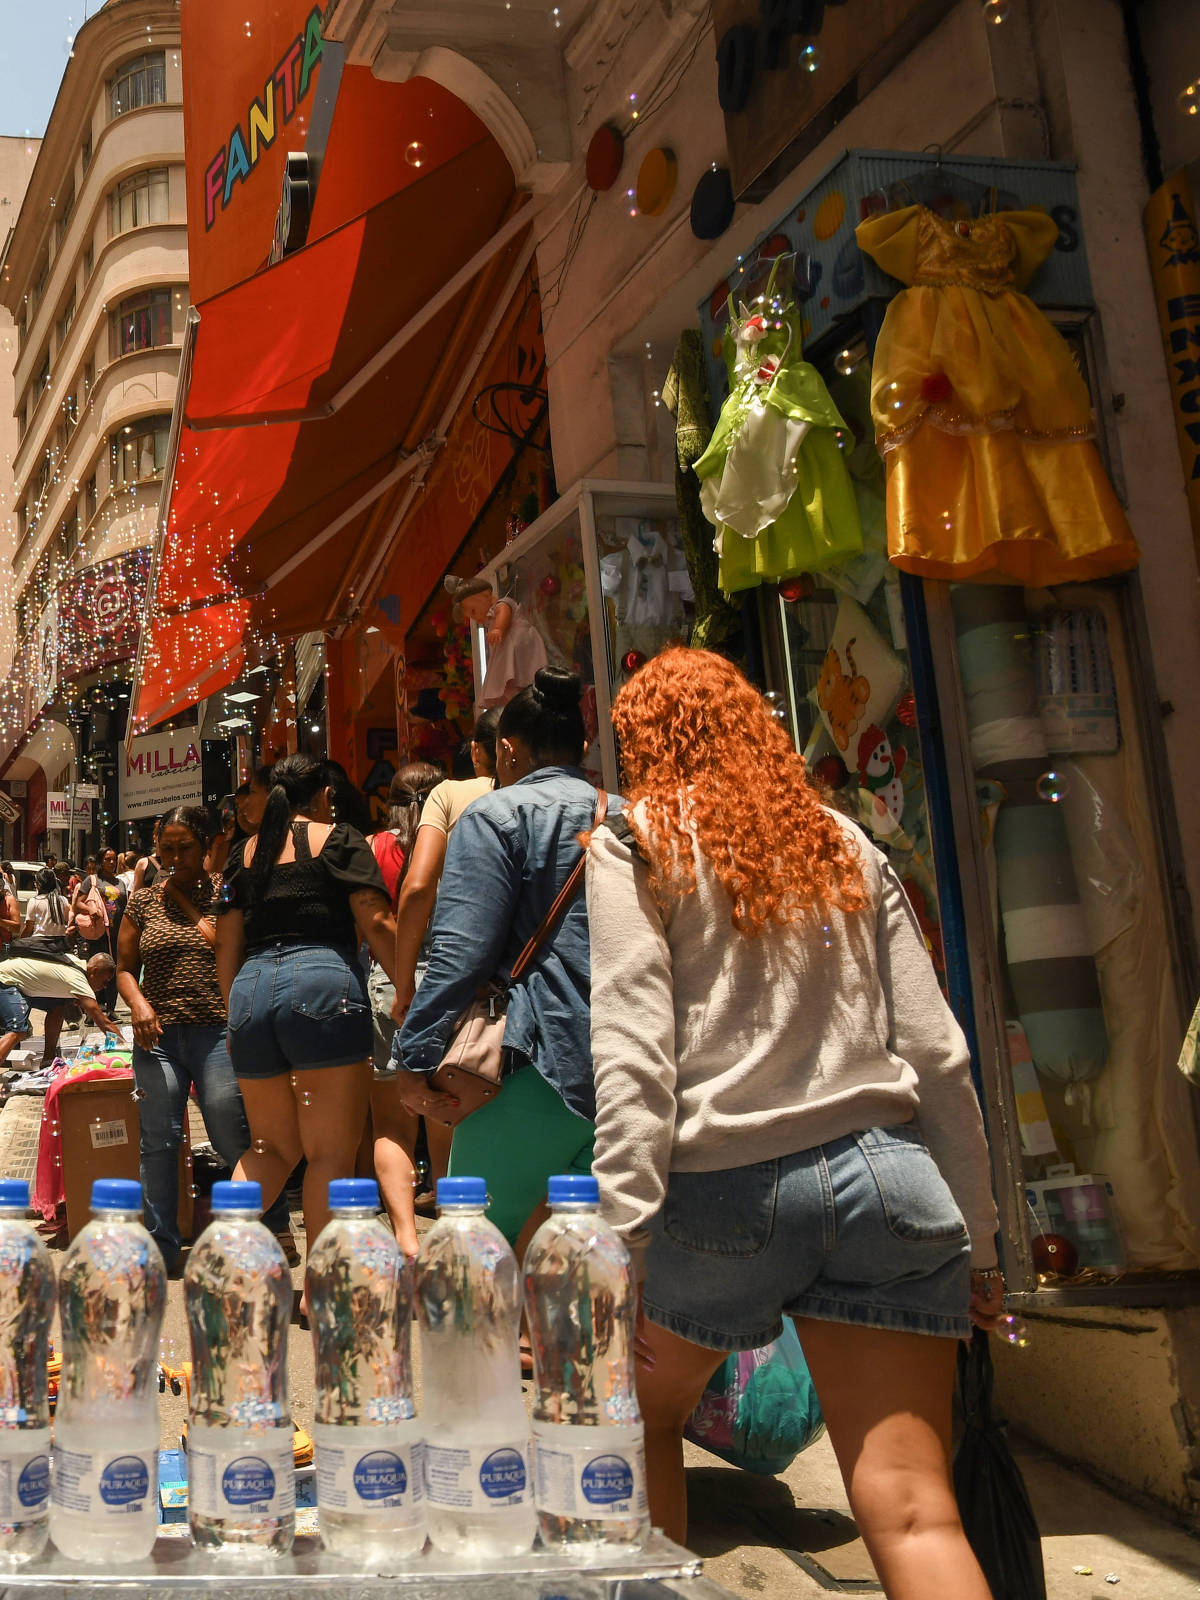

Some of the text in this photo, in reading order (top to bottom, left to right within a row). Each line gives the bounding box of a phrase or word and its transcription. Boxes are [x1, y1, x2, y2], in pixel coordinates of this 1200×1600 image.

[126, 744, 201, 777] MILLA
[223, 1479, 276, 1491] PURAQUA
[355, 1472, 407, 1486] PURAQUA
